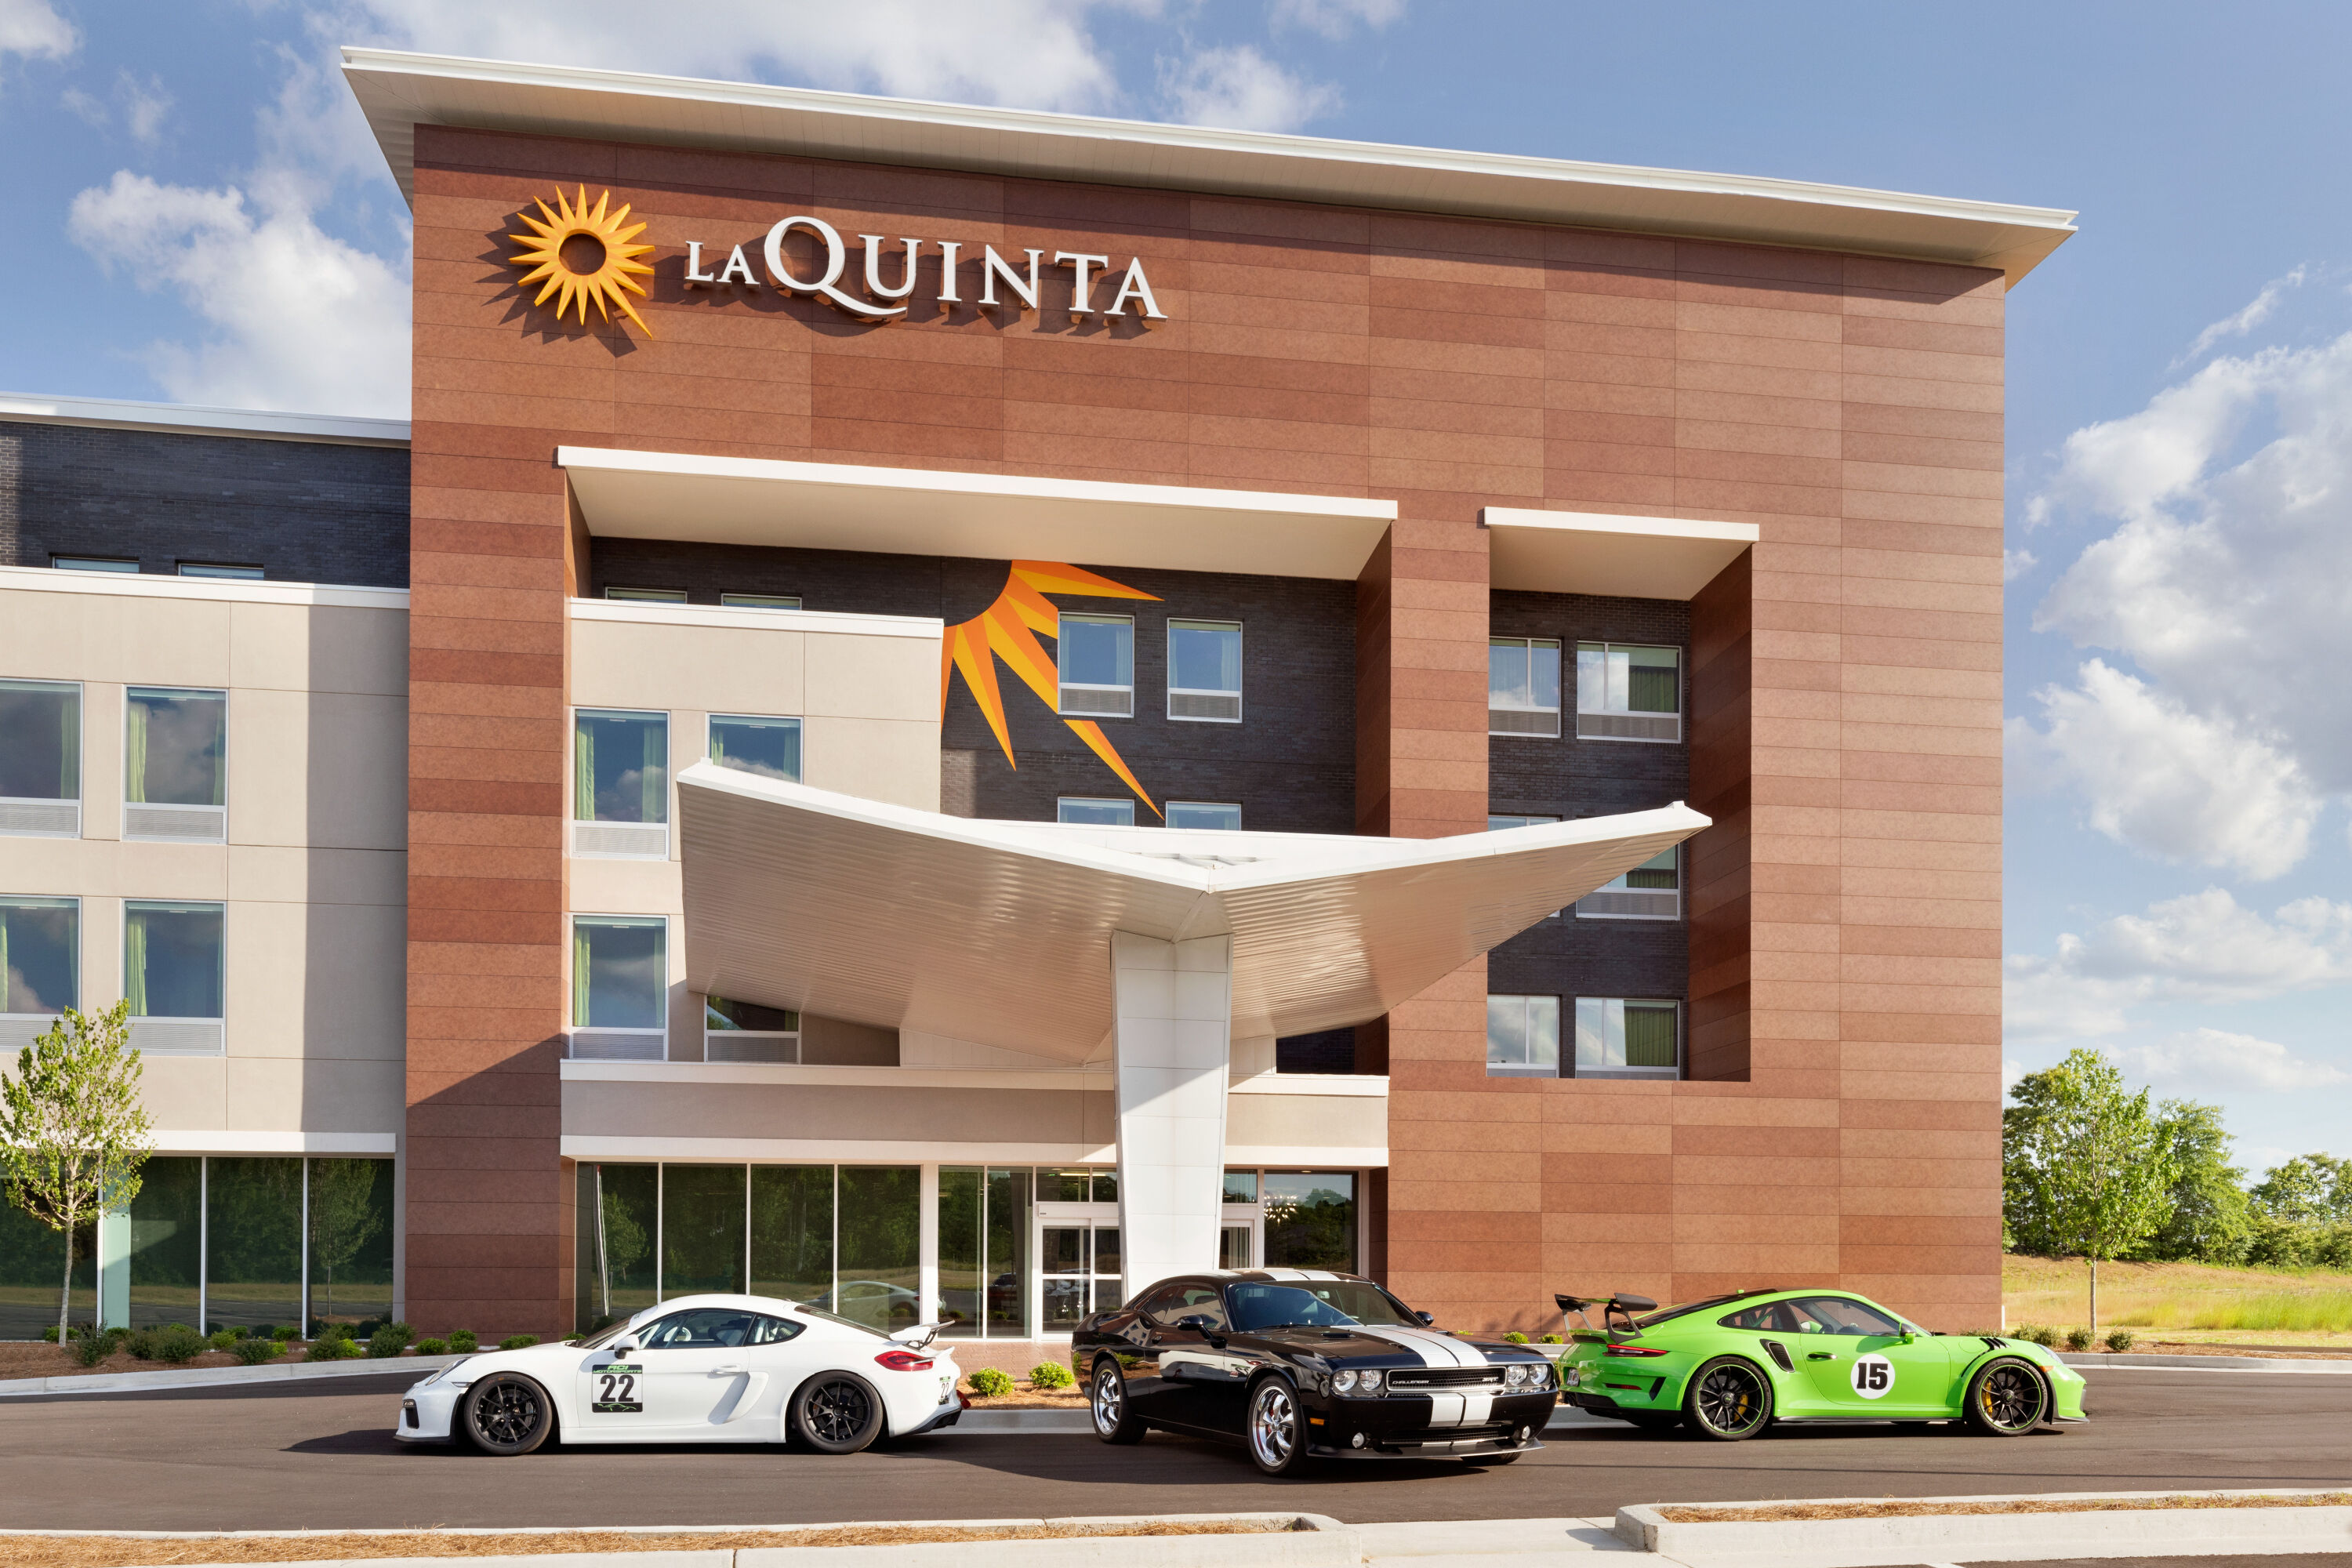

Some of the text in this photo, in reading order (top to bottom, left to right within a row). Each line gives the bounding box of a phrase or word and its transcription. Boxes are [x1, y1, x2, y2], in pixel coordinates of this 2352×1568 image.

[684, 216, 1168, 319] LA QUINTA
[600, 1374, 635, 1403] 22
[941, 1381, 949, 1399] 22
[1856, 1362, 1889, 1390] 15
